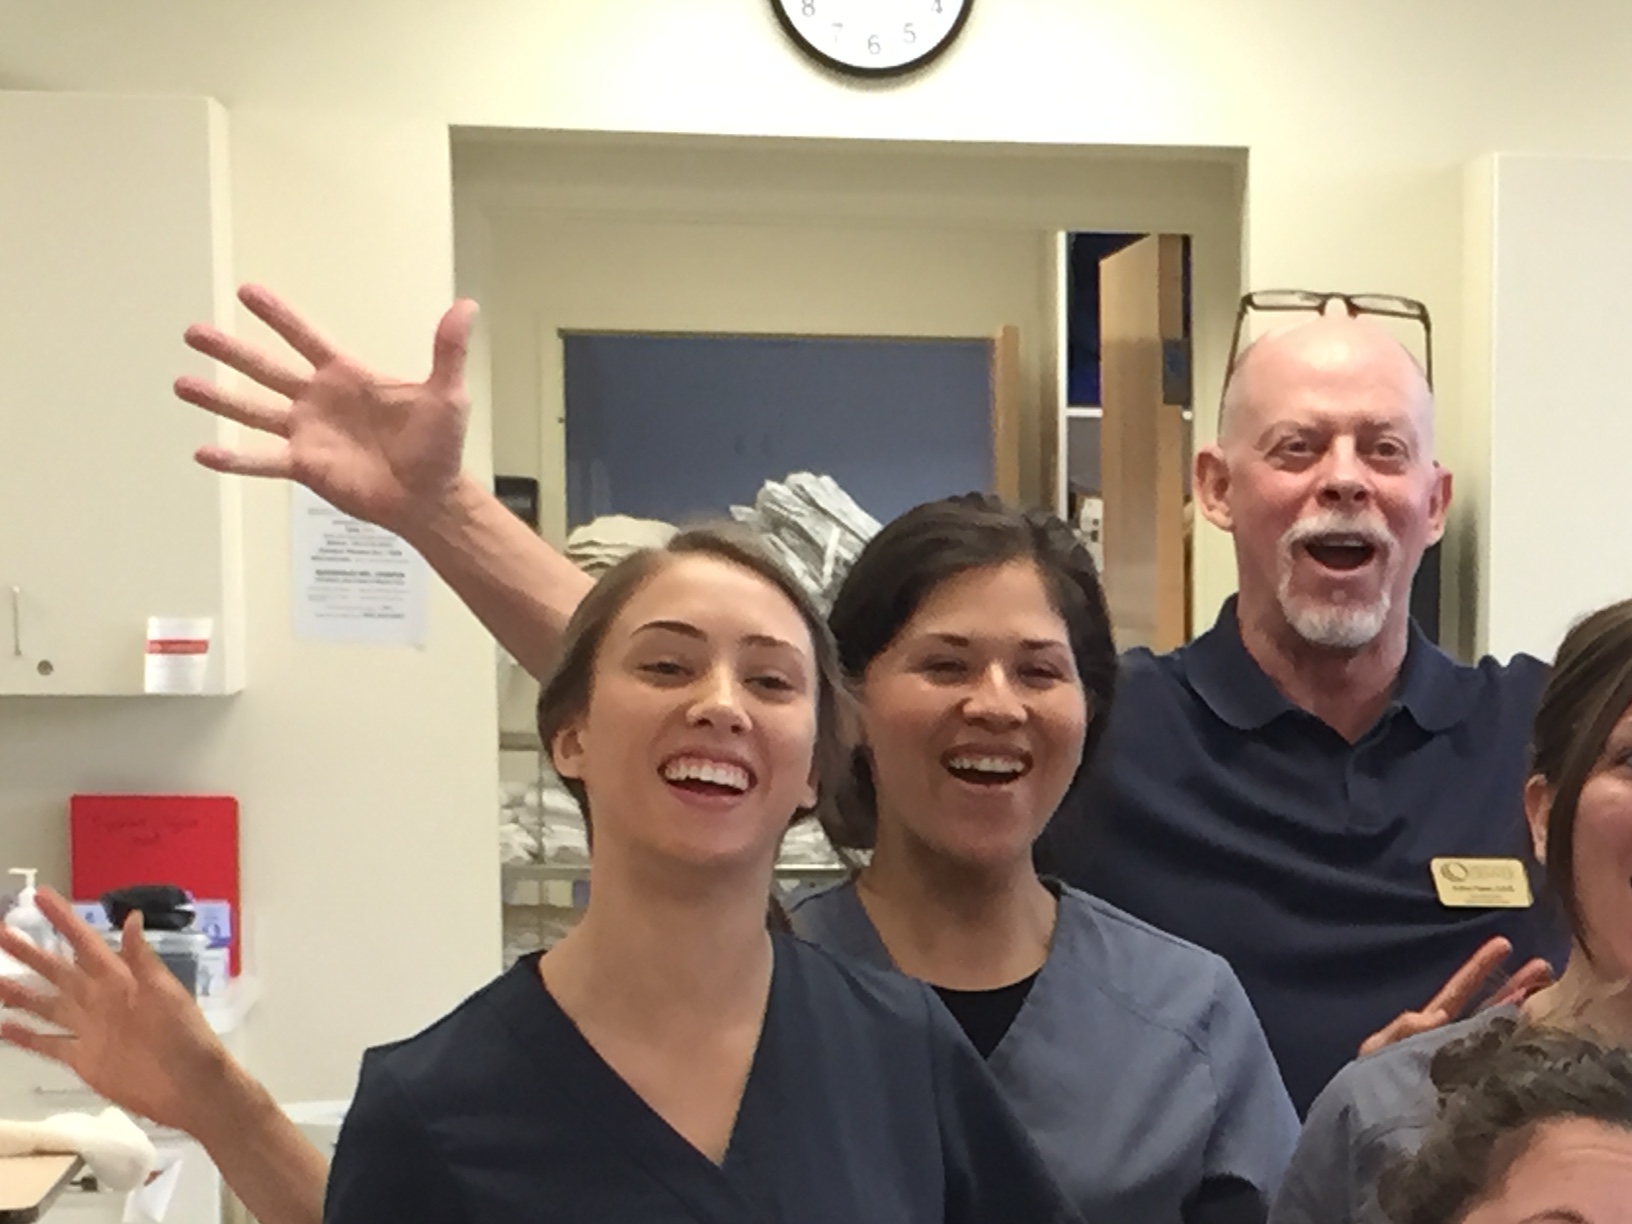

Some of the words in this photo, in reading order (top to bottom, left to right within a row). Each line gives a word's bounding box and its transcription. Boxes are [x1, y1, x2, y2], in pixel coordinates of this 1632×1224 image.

[802, 0, 815, 17] 8
[832, 23, 843, 42] 7
[903, 23, 916, 43] 5
[867, 35, 881, 55] 6
